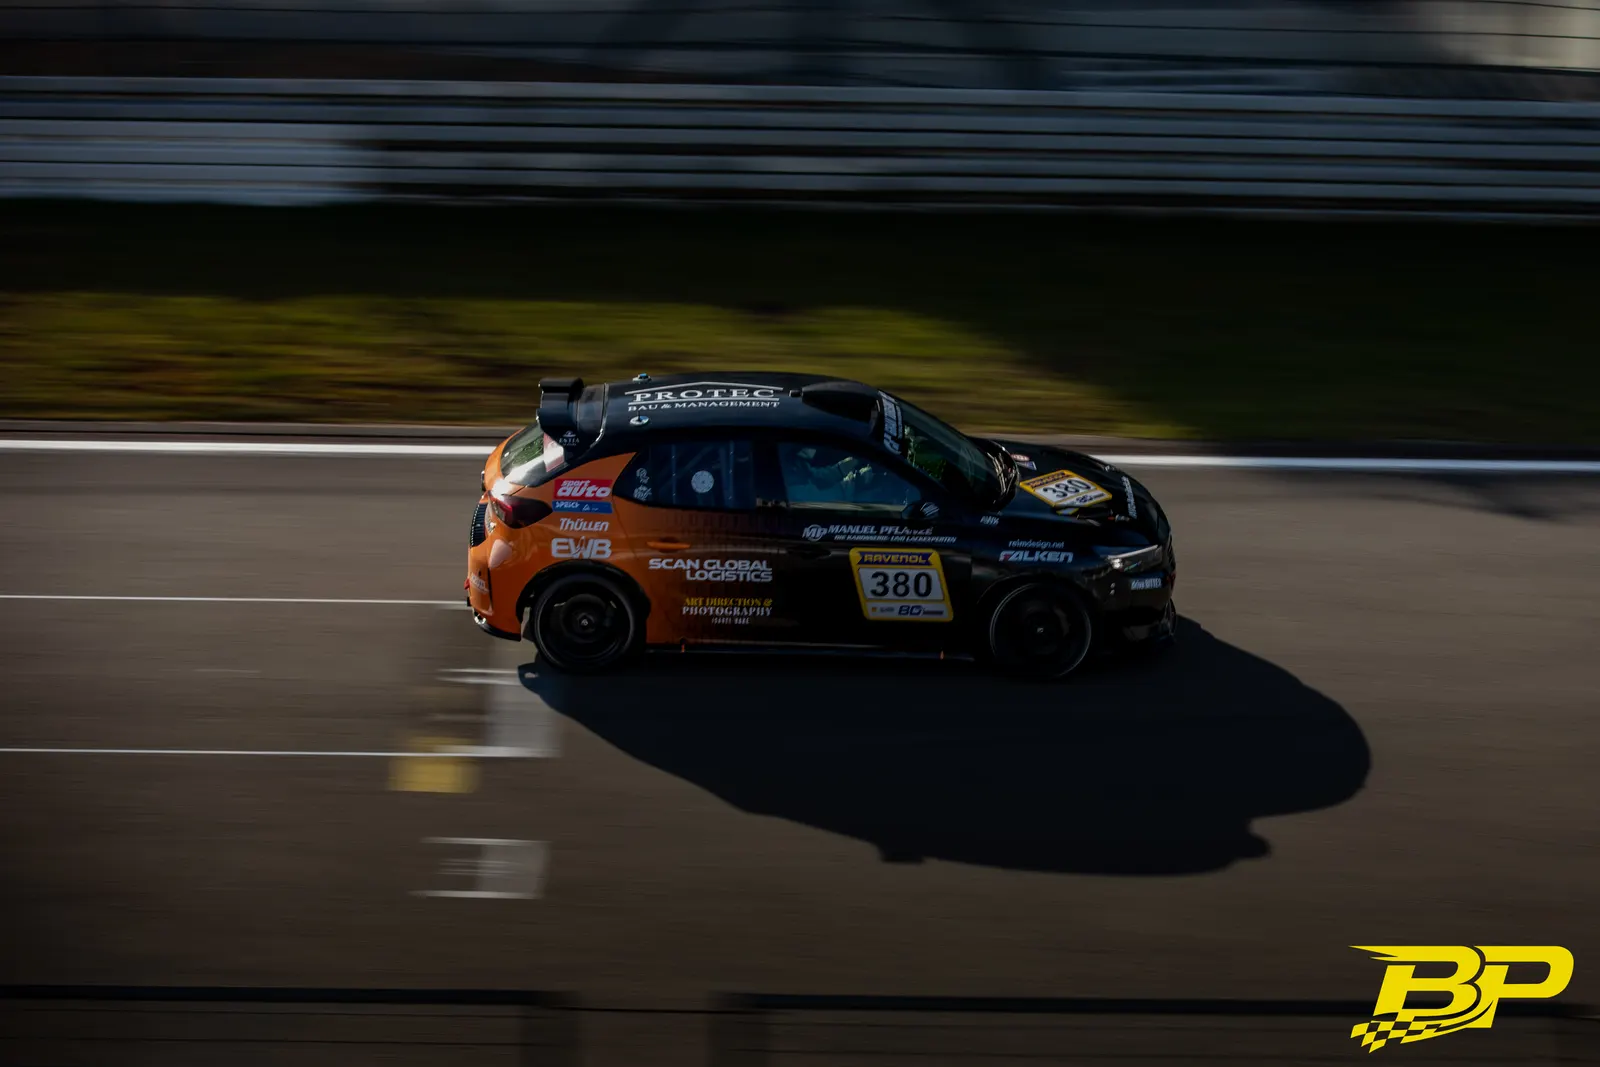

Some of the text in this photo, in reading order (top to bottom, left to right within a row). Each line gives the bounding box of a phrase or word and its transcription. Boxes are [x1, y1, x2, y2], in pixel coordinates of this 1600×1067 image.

[633, 388, 775, 402] PROTEC
[628, 404, 658, 412] BAU
[674, 401, 780, 409] MANAGEMENT
[561, 480, 591, 488] sport
[1043, 479, 1091, 498] 380
[556, 485, 611, 498] auto
[828, 524, 877, 535] MANUEL
[551, 536, 612, 559] EWB
[863, 553, 928, 564] RAVENOL
[998, 550, 1075, 563] FALKEN
[648, 557, 773, 571] SCAN GLOBAL
[685, 570, 773, 583] LOGISTICS
[870, 571, 932, 598] 380
[685, 597, 773, 607] ART DIRECTION &
[681, 606, 773, 616] PHOTOGRAPHY
